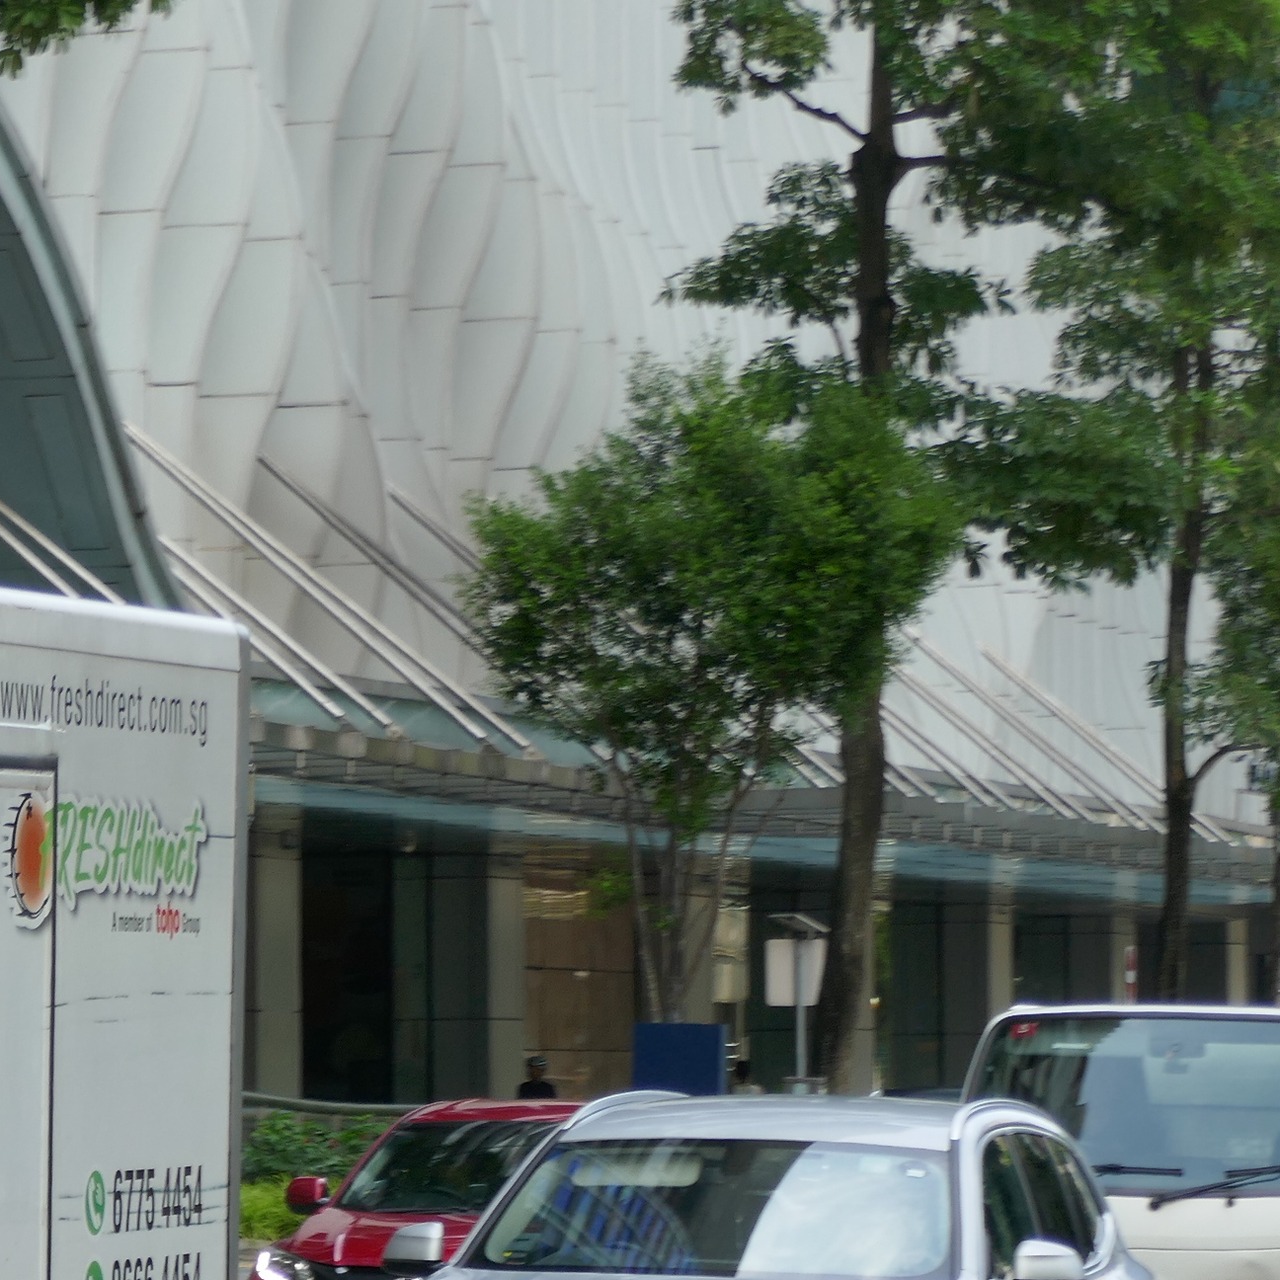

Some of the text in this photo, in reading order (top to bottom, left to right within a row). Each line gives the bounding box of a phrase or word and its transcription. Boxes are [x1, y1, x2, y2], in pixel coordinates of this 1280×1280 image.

[0, 674, 208, 748] www.freshdirect.com.sg
[38, 800, 203, 901] FRESHdirect
[113, 1164, 203, 1234] 6775 4454
